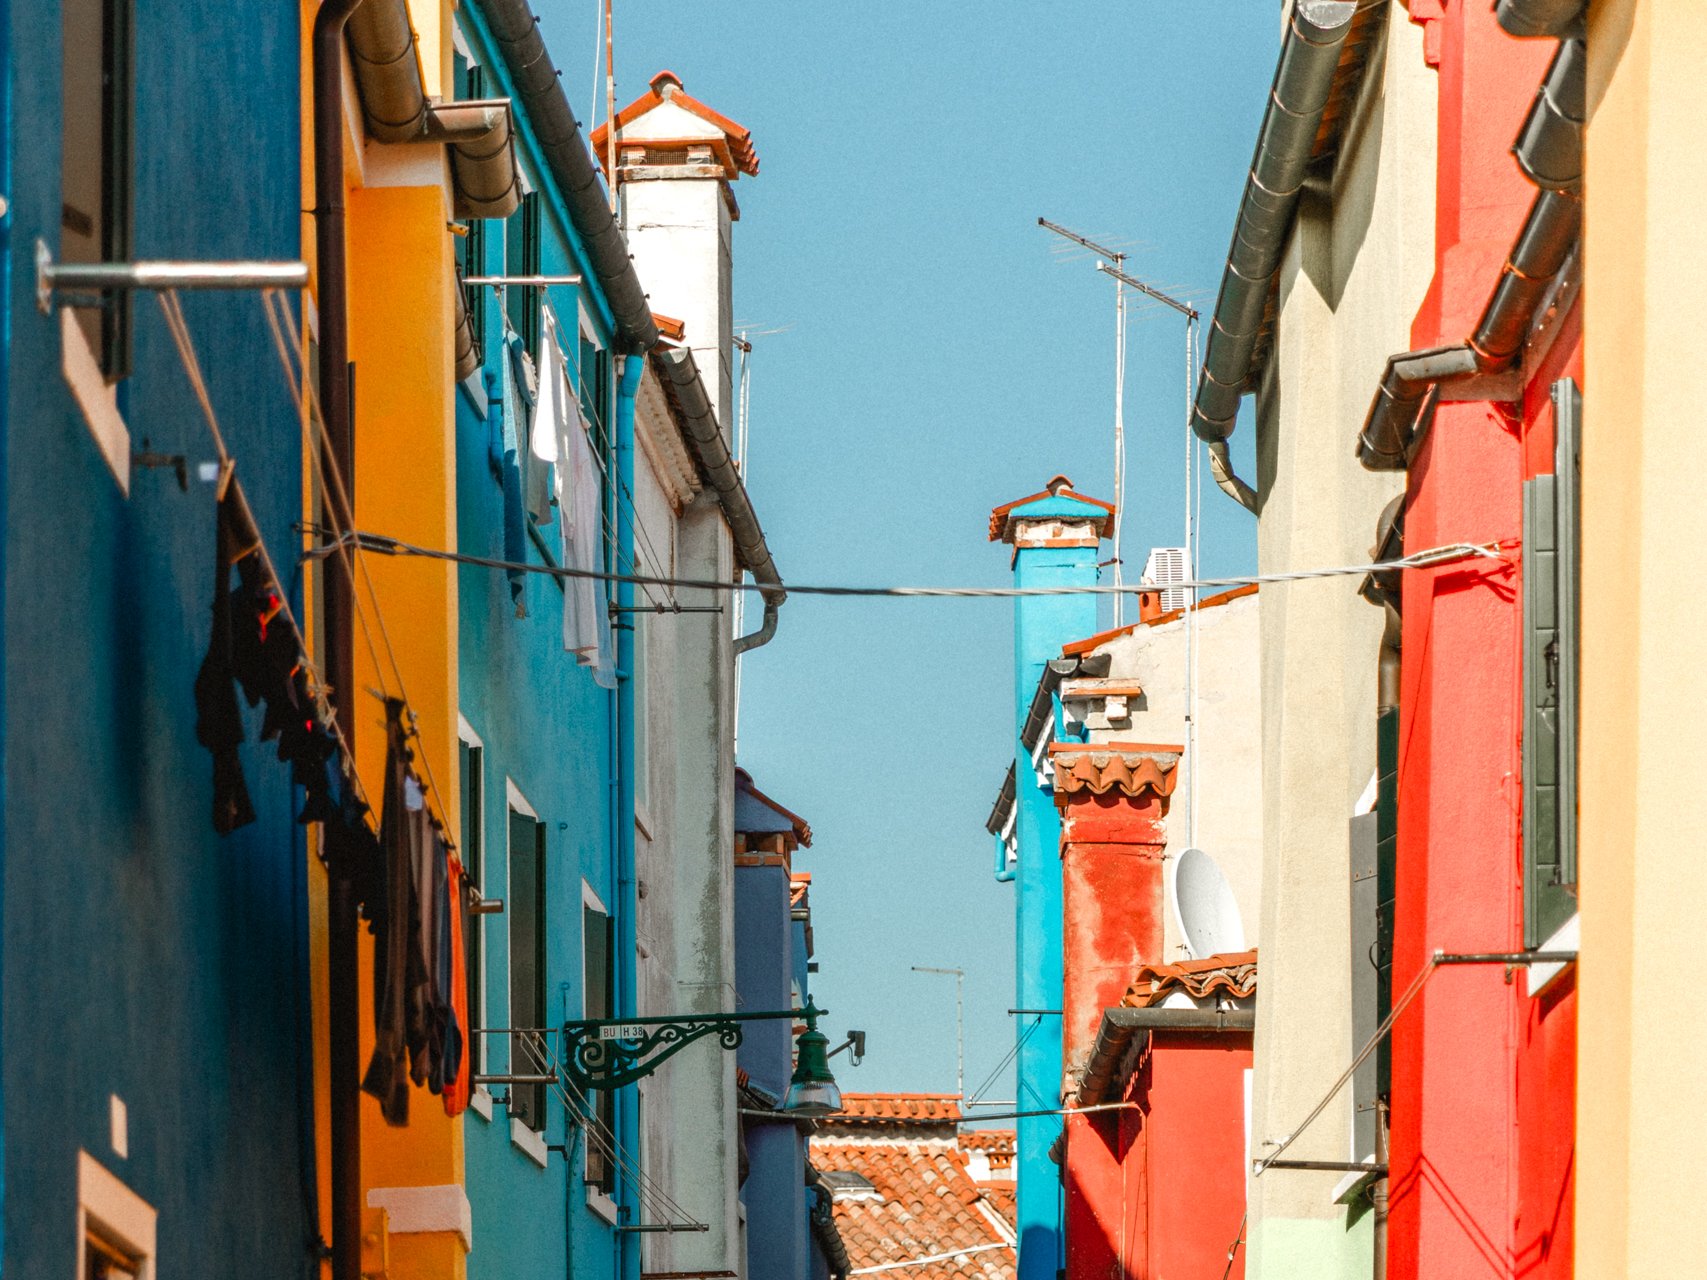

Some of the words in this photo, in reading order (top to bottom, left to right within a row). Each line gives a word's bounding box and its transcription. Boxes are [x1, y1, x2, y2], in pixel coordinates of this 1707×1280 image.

[604, 1028, 616, 1037] BU
[624, 1027, 629, 1036] H
[633, 1027, 642, 1036] 38
